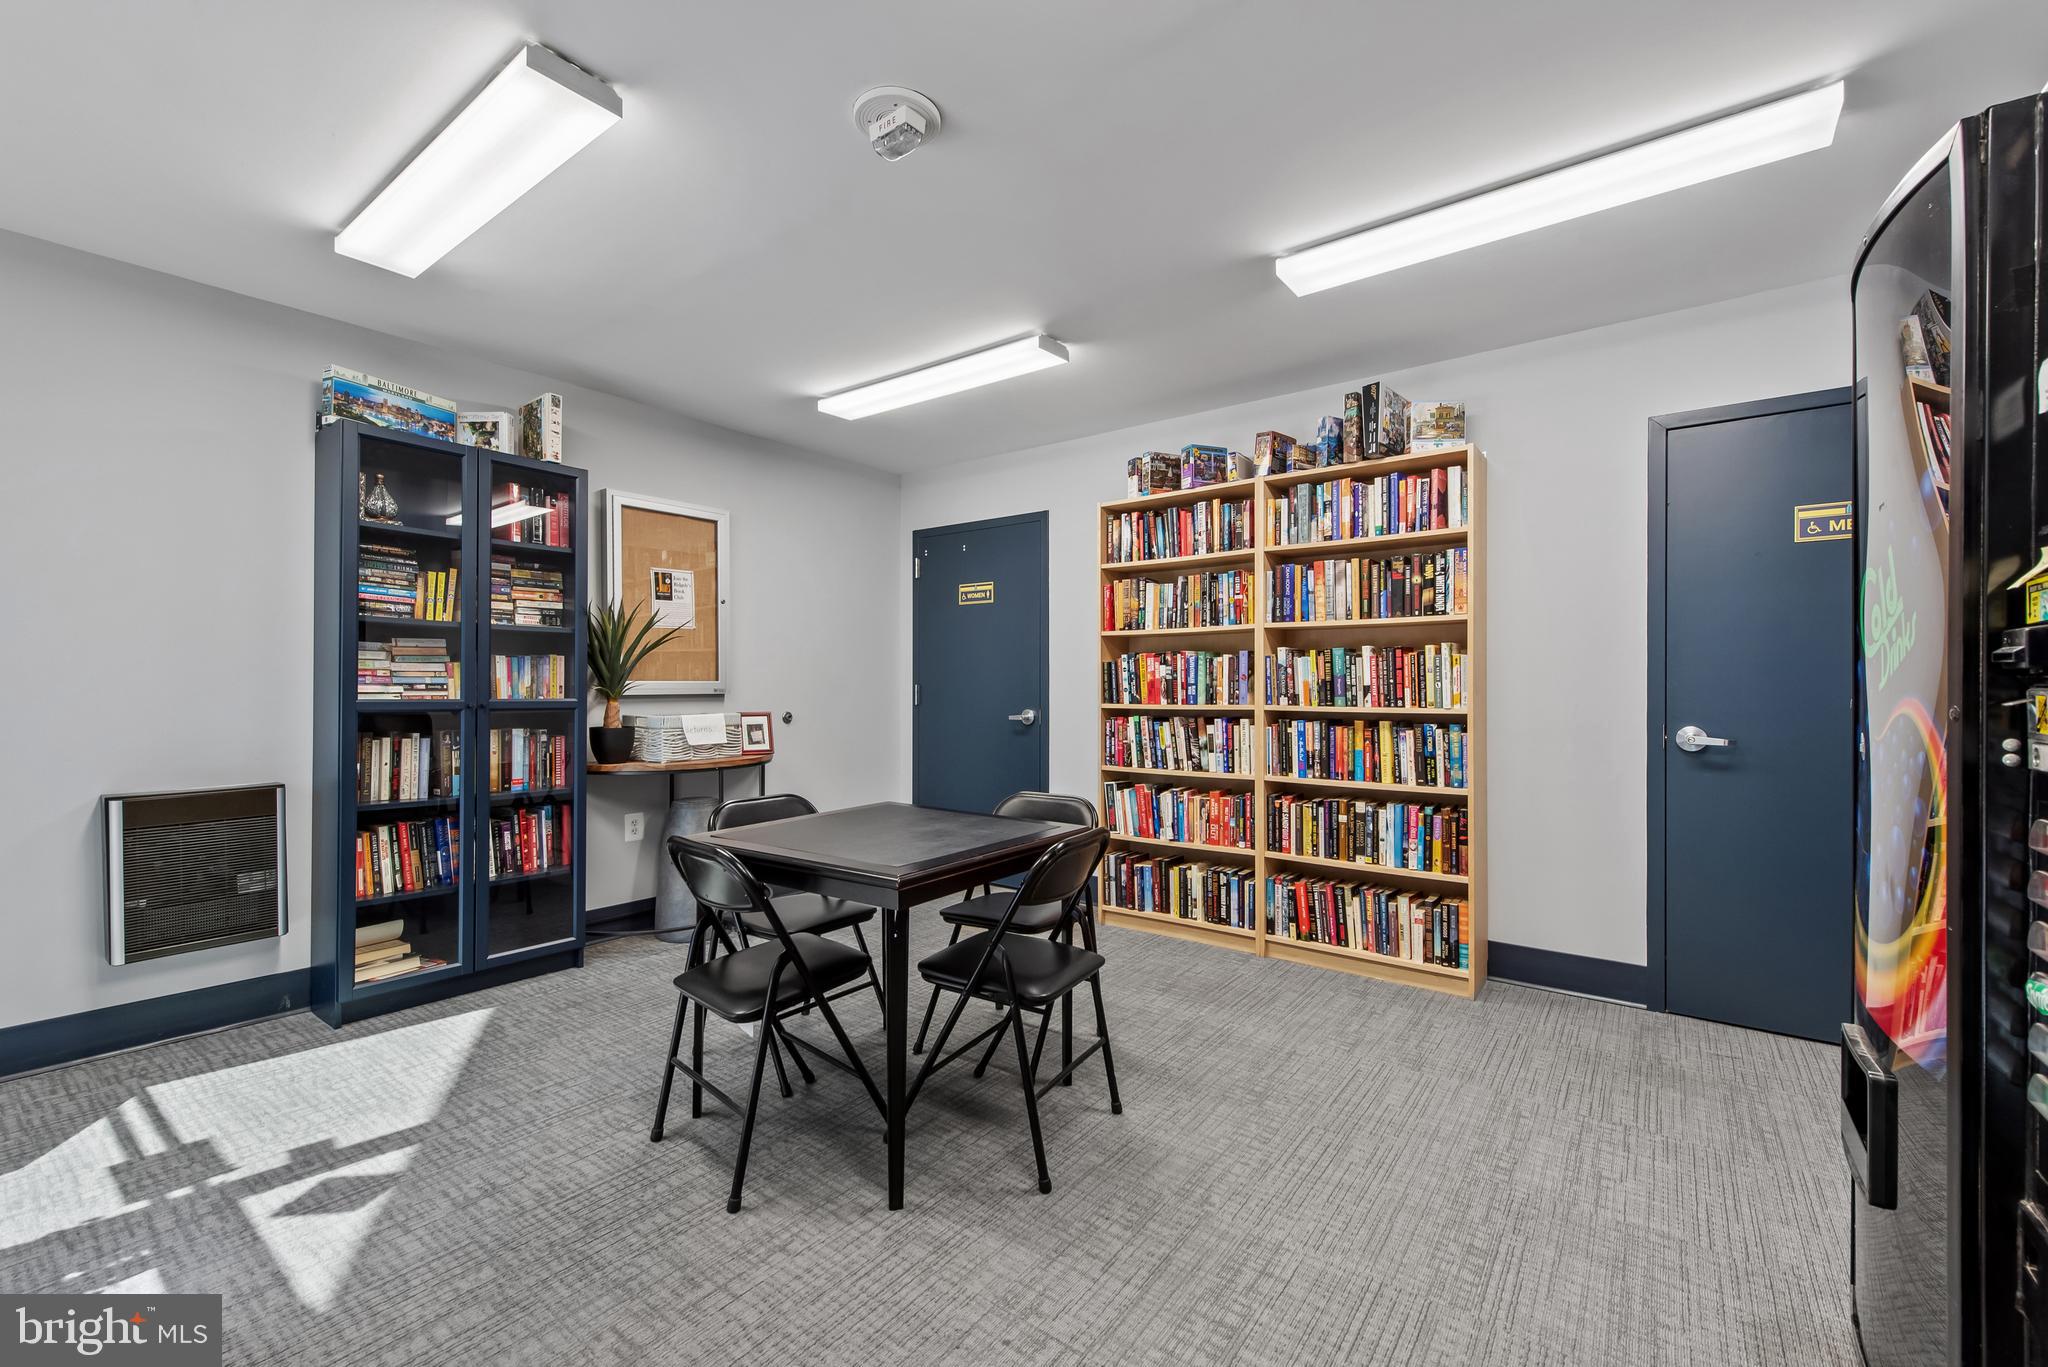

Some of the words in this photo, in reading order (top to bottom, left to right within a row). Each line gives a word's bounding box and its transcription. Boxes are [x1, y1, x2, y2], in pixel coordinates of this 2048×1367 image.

[878, 115, 896, 131] FIRE
[377, 379, 417, 398] BALTIMORE
[1829, 518, 1853, 532] ME
[1424, 564, 1434, 579] NINJA
[1435, 575, 1445, 593] WHITE
[1434, 594, 1445, 612] NINJA
[1860, 544, 1904, 658] Cold
[1415, 727, 1423, 753] SHATTERED
[1281, 800, 1289, 813] JOHN
[1281, 813, 1290, 840] SANDFORD
